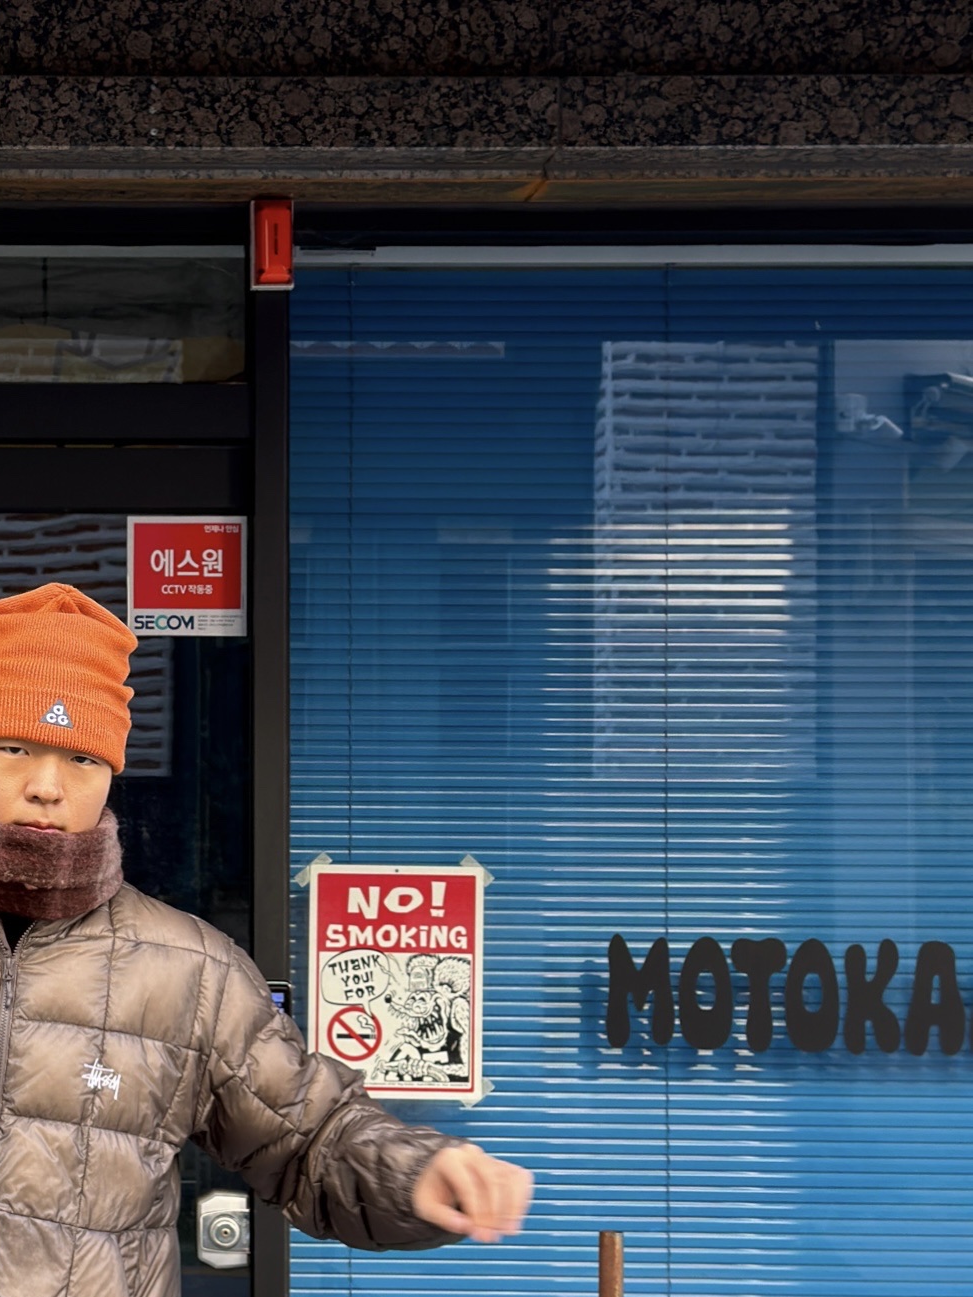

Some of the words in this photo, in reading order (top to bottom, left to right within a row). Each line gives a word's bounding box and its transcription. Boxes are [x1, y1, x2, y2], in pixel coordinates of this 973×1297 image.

[150, 549, 223, 577] 에스원
[161, 585, 187, 594] CCTV
[188, 585, 213, 595] 작동중
[134, 614, 195, 630] SECOM
[347, 881, 447, 919] NO!
[341, 971, 373, 987] YOU!
[344, 985, 375, 1001] FOR
[606, 933, 973, 1056] MOTOKA
